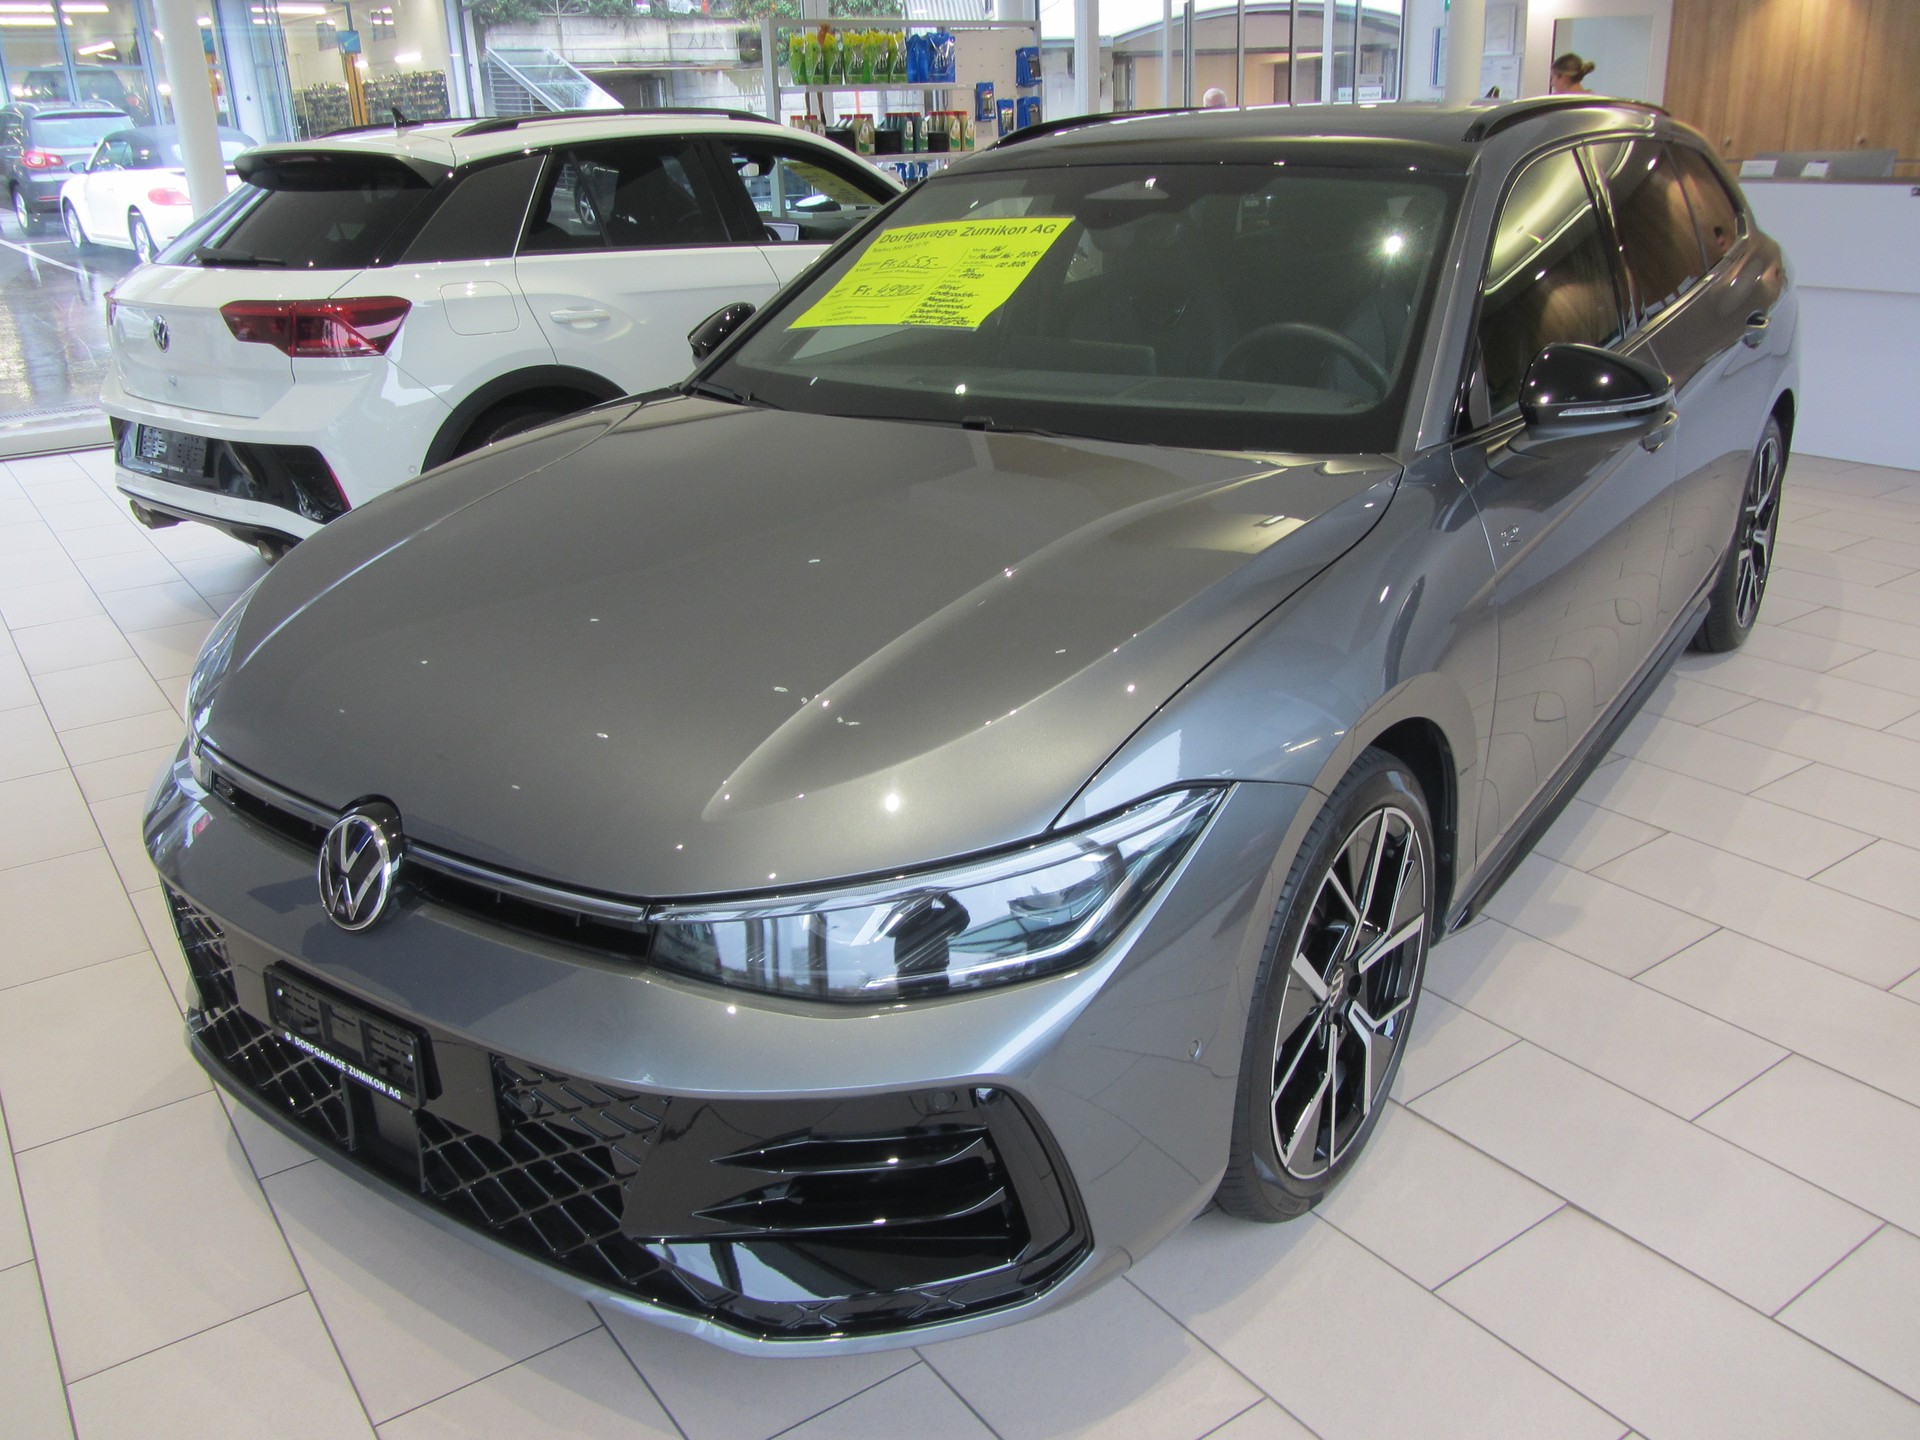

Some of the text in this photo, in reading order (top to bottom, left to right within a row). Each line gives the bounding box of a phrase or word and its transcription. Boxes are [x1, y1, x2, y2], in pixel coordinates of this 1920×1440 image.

[879, 223, 1058, 244] Dorfgarage Zumikon AG
[852, 285, 871, 296] Fr.
[320, 815, 391, 929] VW
[294, 1036, 401, 1100] DORFGARAGE ZUMIKON AG
